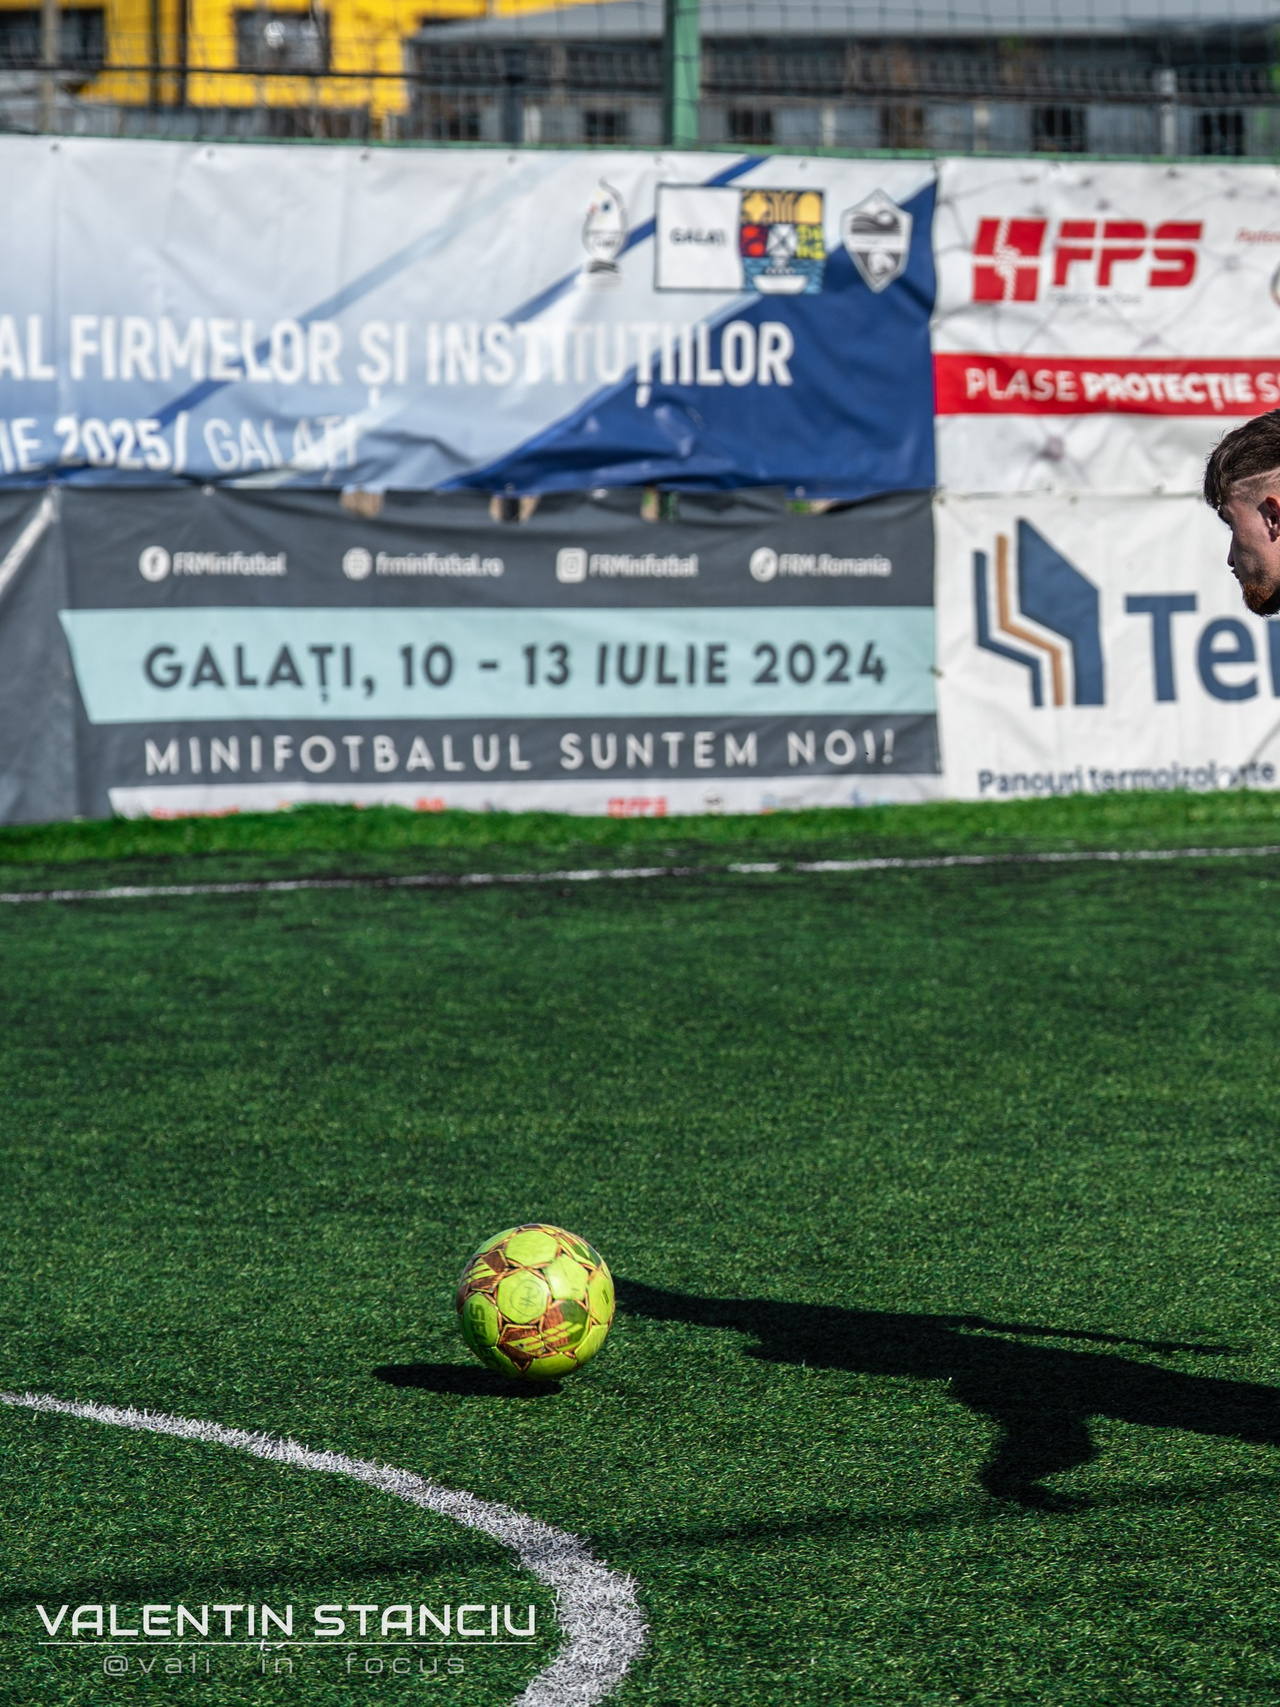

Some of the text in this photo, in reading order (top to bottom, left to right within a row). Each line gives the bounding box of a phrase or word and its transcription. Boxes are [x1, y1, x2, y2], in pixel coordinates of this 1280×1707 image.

[1053, 218, 1203, 288] FPS
[0, 314, 57, 382] AL
[69, 314, 344, 384] FIRMELOR
[964, 366, 1079, 402] PLASE
[399, 642, 455, 688] 10
[522, 641, 571, 686] 13
[597, 641, 729, 686] IULIE
[751, 640, 887, 686] 2024
[144, 728, 896, 776] MINIFOTBALUL SUNTEM NOI!
[976, 764, 1083, 796] Panouri
[1088, 758, 1277, 793] termoizolnte
